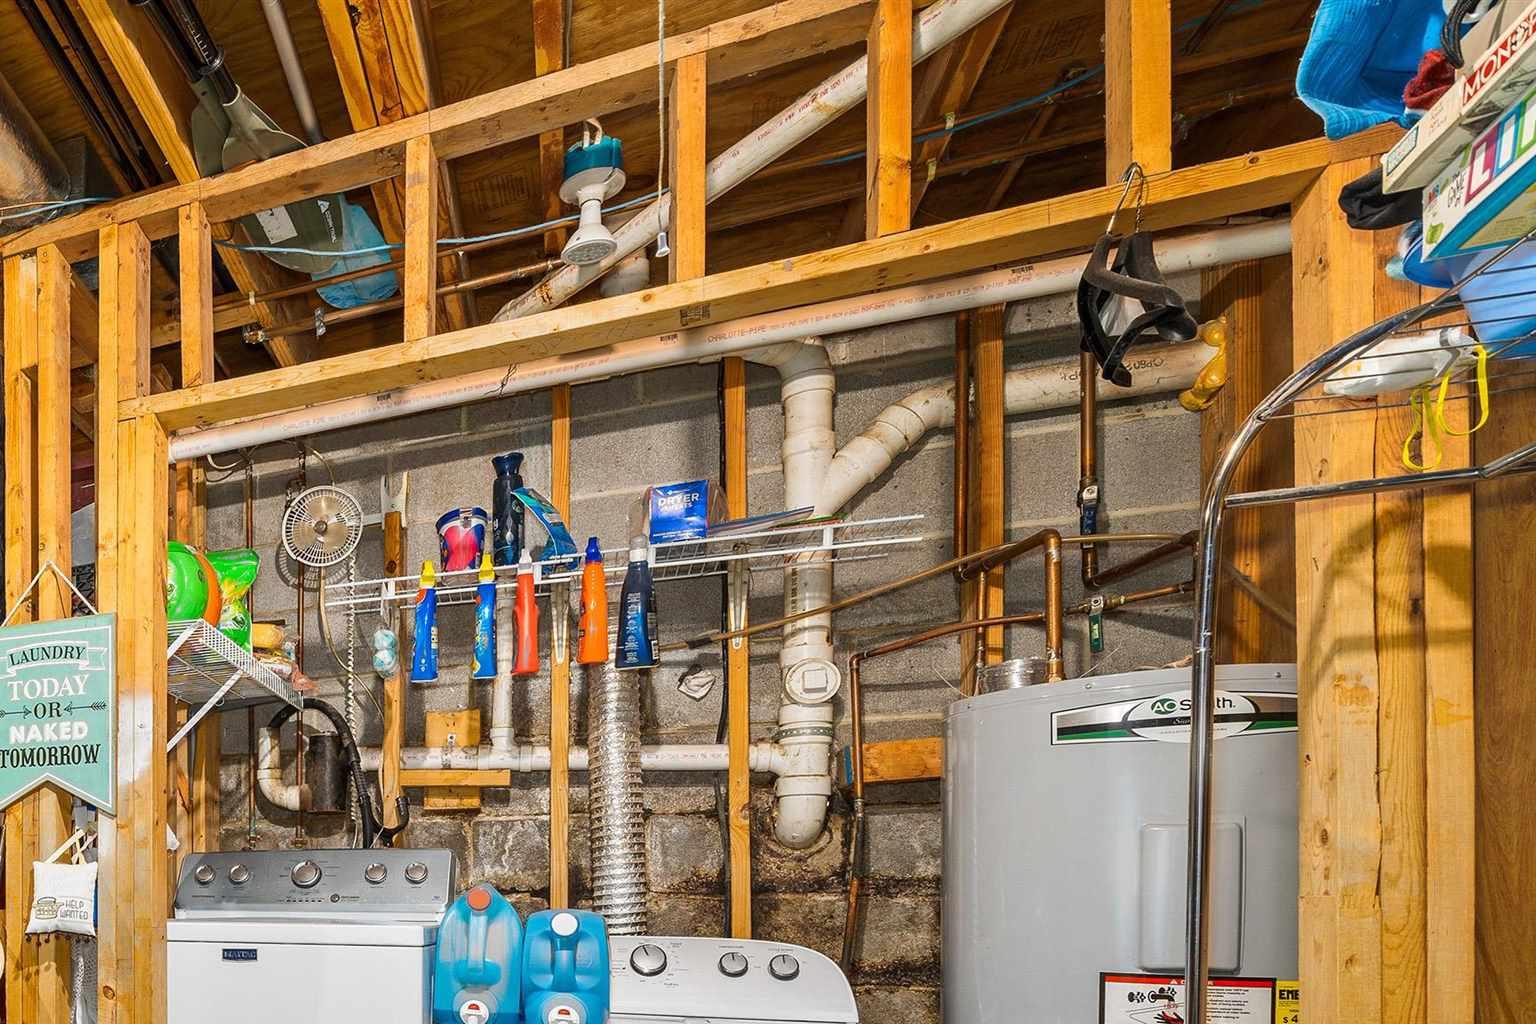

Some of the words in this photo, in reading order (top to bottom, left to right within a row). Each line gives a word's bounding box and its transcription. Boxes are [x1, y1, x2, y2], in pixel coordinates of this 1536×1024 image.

[658, 493, 700, 507] DRYER
[9, 646, 86, 666] LAUNDRY
[8, 674, 89, 701] TODAY
[34, 702, 62, 719] OR
[9, 721, 88, 744] NAKED
[65, 899, 84, 909] HELP
[59, 909, 89, 920] WANTED
